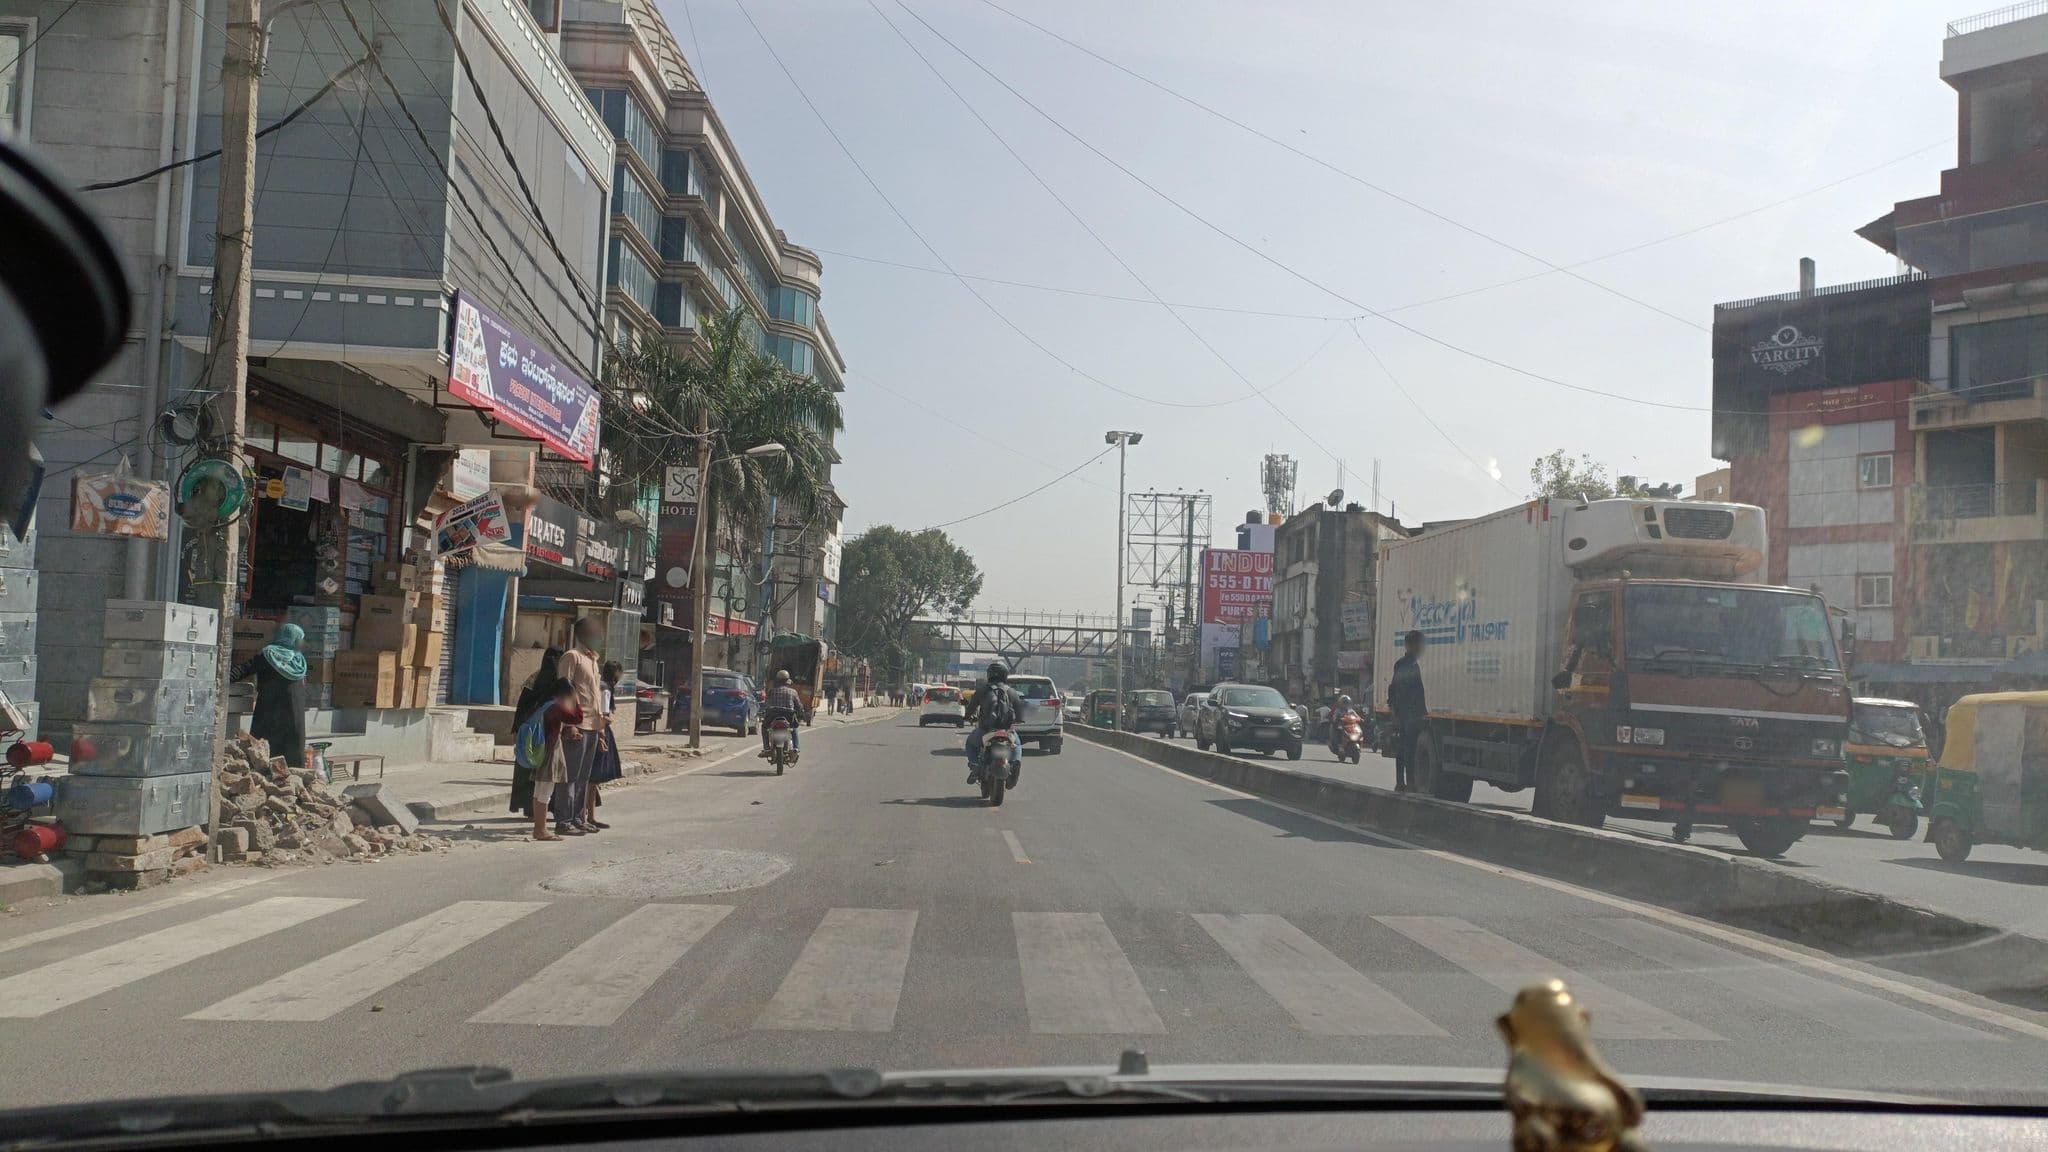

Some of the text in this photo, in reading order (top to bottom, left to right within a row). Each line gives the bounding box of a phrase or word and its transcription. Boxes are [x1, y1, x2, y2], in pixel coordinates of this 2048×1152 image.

[1751, 346, 1824, 364] VARCITY
[452, 504, 467, 516] 2022
[661, 505, 697, 516] HOTE
[1211, 552, 1273, 573] INDU
[1729, 716, 1759, 728] TATA
